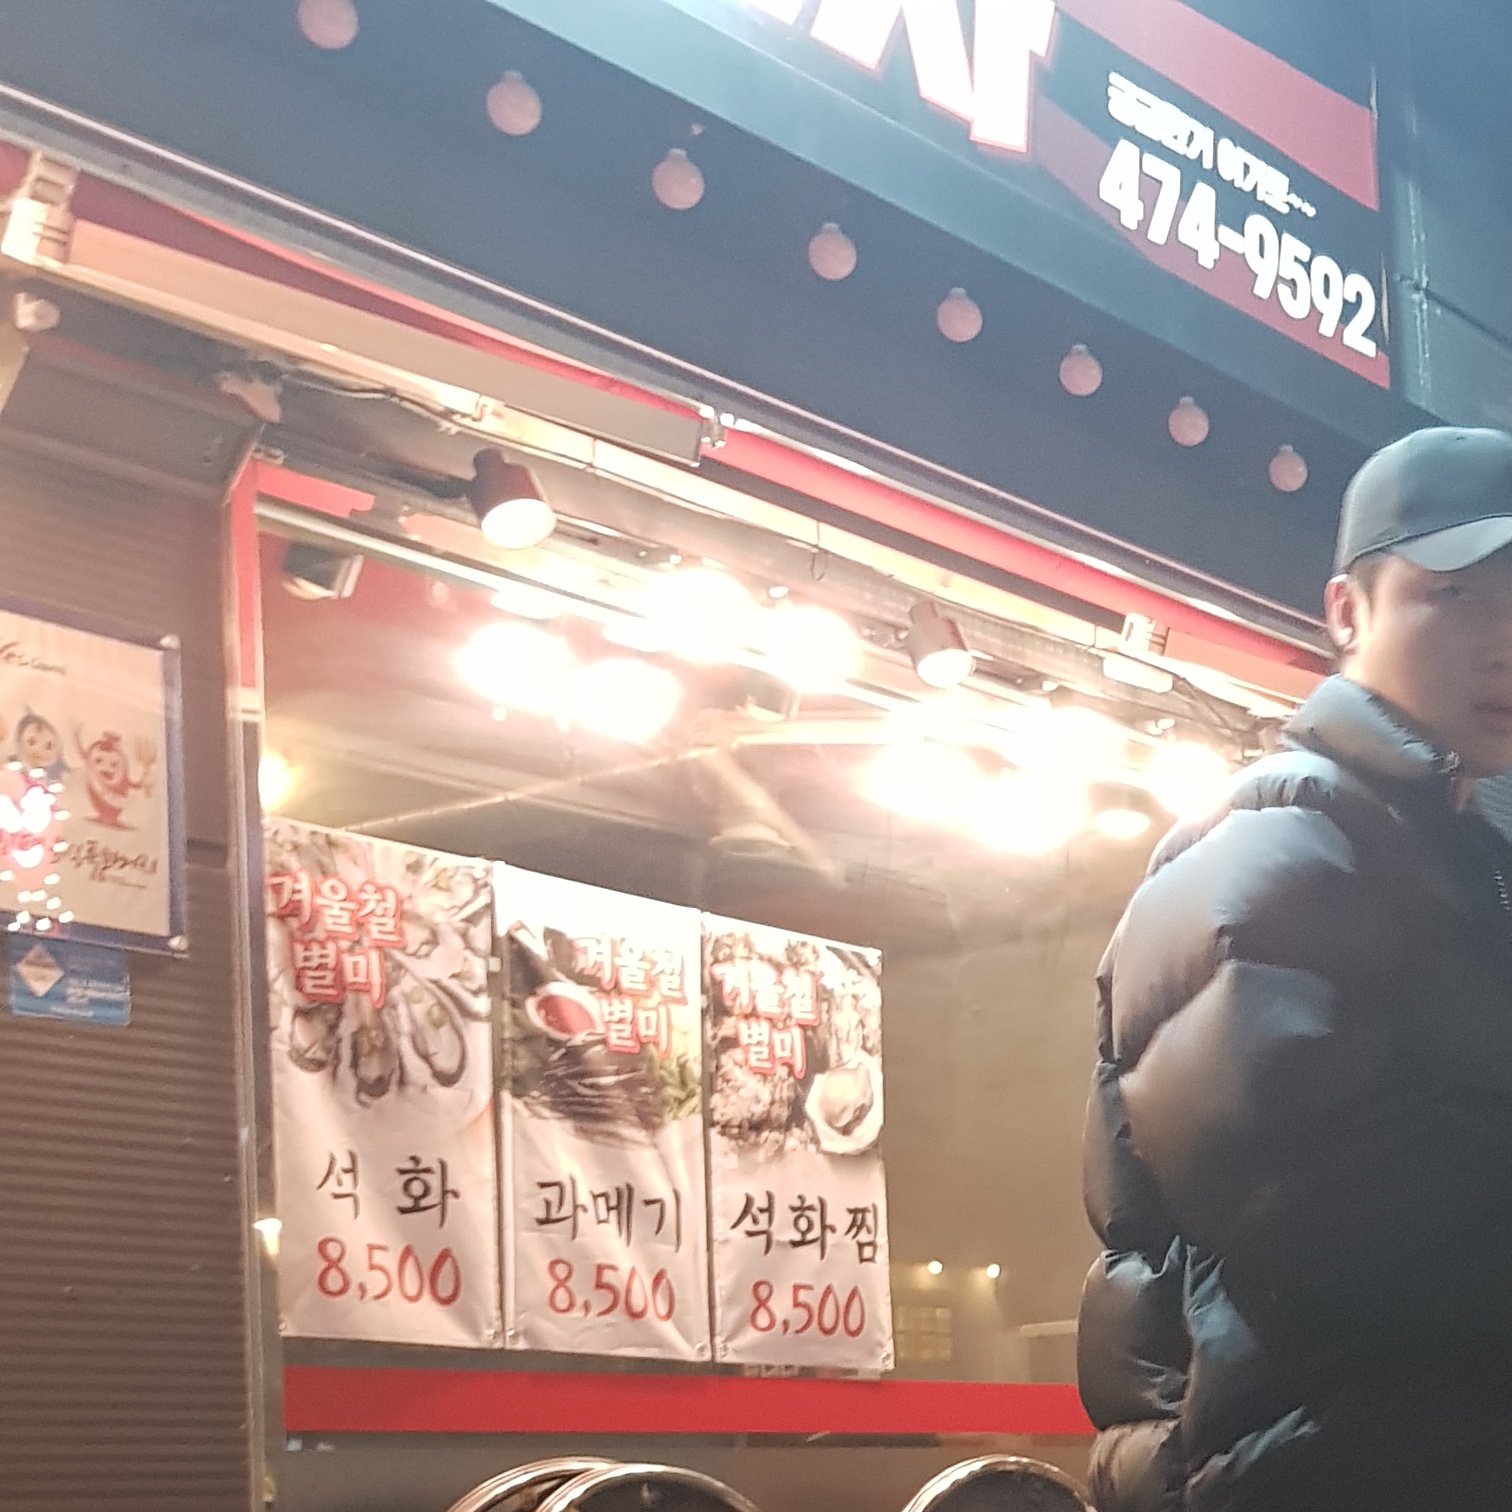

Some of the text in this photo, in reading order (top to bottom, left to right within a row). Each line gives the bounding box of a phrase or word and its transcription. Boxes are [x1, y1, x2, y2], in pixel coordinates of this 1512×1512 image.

[1098, 138, 1378, 358] 474-9592
[267, 870, 402, 944] 겨울철
[293, 938, 386, 1007] 별미
[575, 934, 688, 1003] 겨울철
[714, 959, 818, 1028] 겨울철
[599, 992, 671, 1057] 별미
[736, 1016, 805, 1079] 별미
[535, 1174, 684, 1253] 과메기
[730, 1189, 879, 1264] 석화찜
[317, 1236, 462, 1306] 8,500
[546, 1257, 676, 1322] 8,500
[749, 1280, 867, 1340] 8,500
